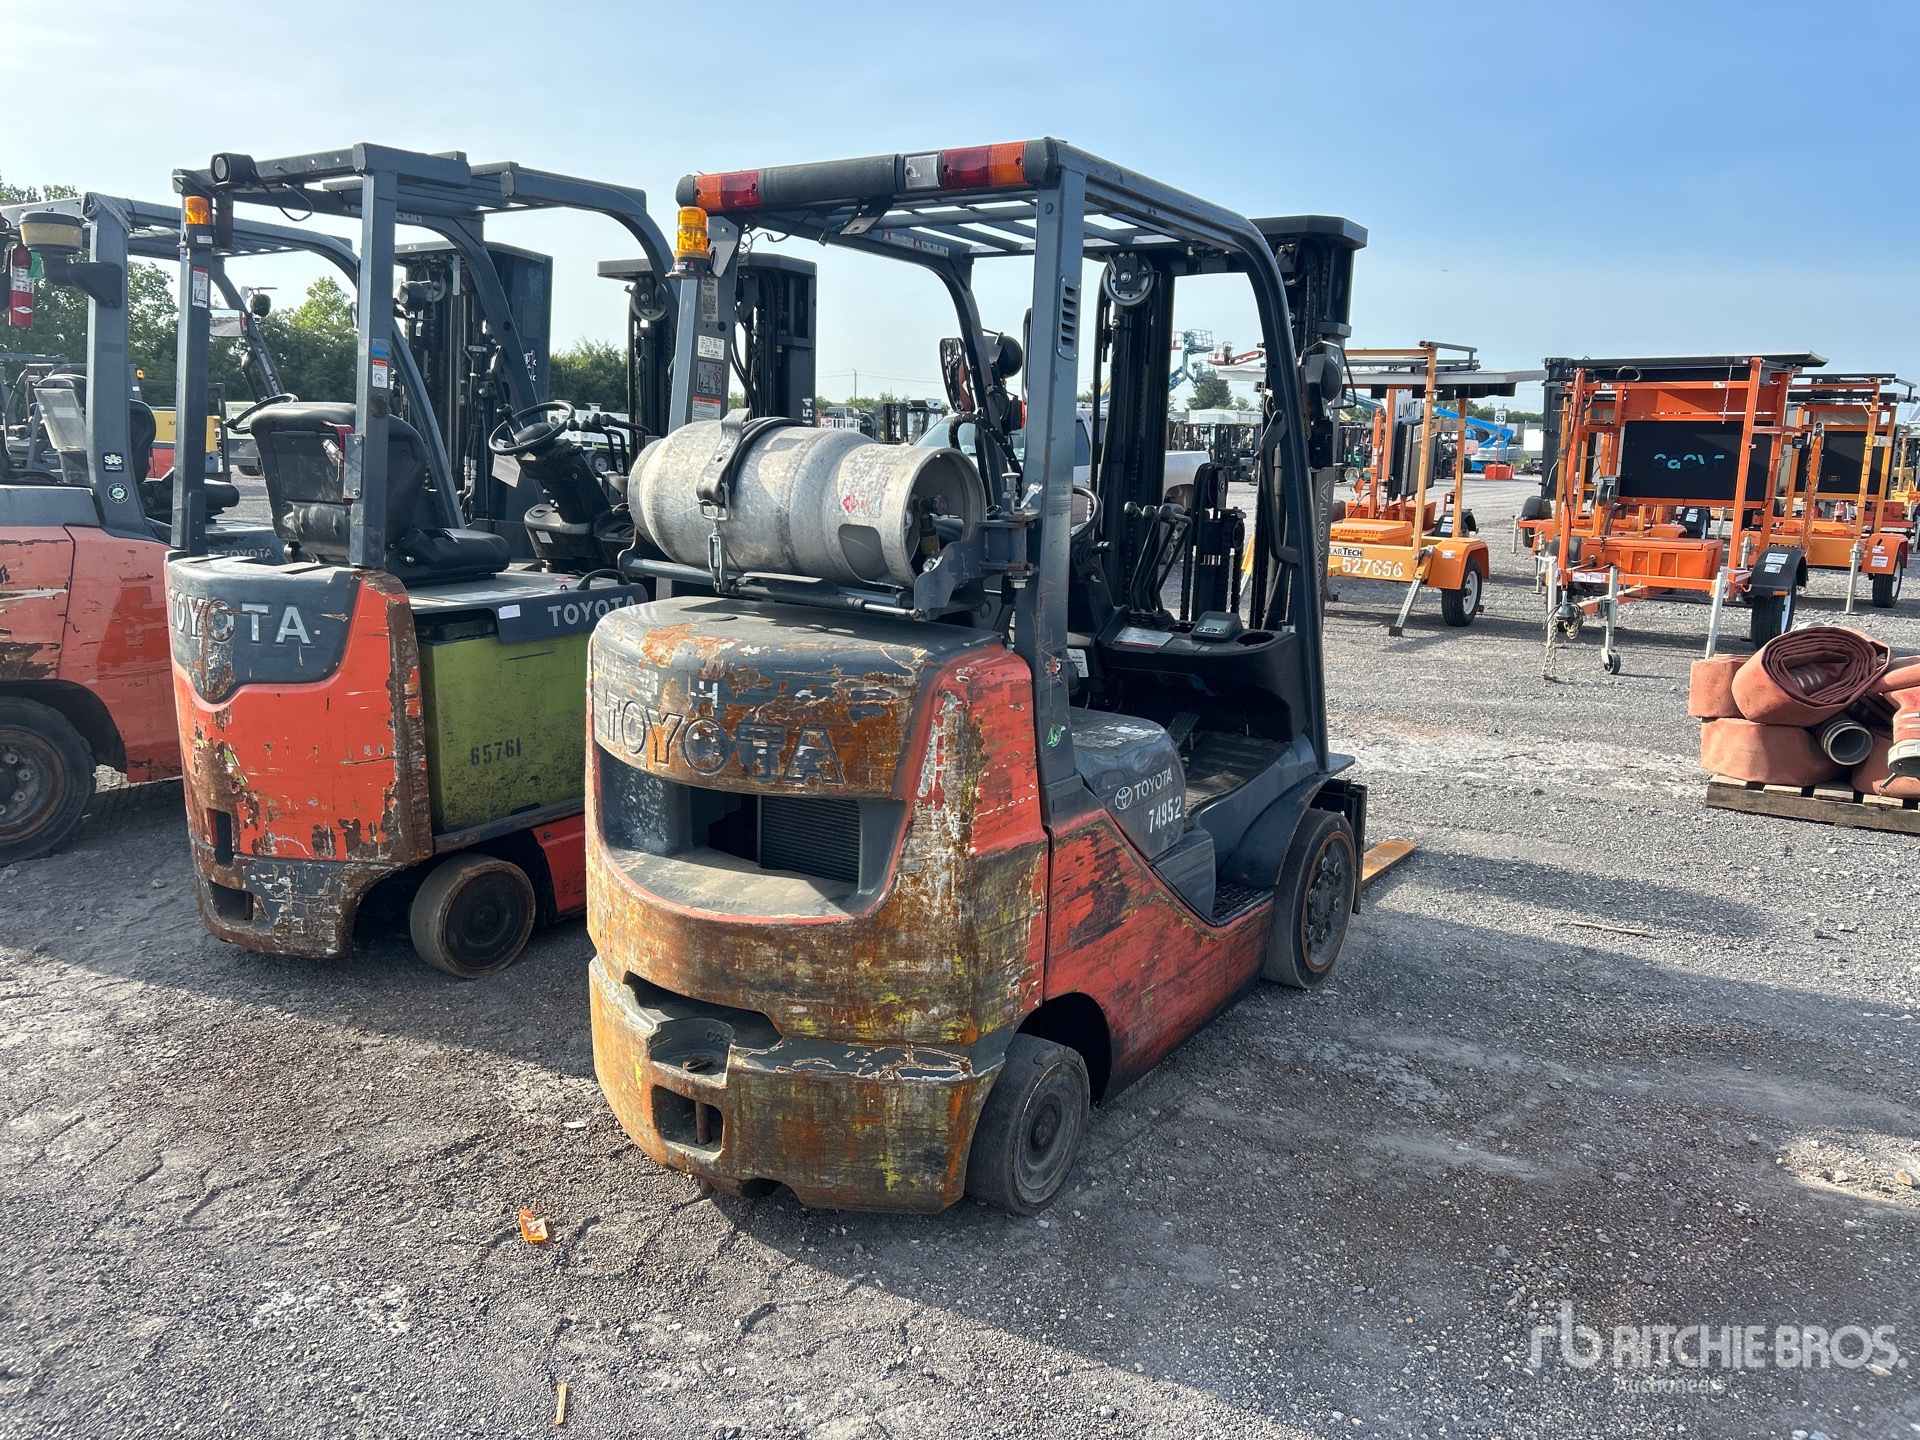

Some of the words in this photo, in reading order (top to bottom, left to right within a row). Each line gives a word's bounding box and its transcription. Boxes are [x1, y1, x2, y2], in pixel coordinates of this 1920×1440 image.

[1398, 401, 1417, 418] LIMIT
[1341, 557, 1403, 578] 527656
[169, 588, 312, 645] TOYOTA
[470, 738, 521, 766] 65761
[604, 689, 846, 786] TOYOTA
[1134, 768, 1173, 800] TOYOTA
[1148, 795, 1182, 834] 74952
